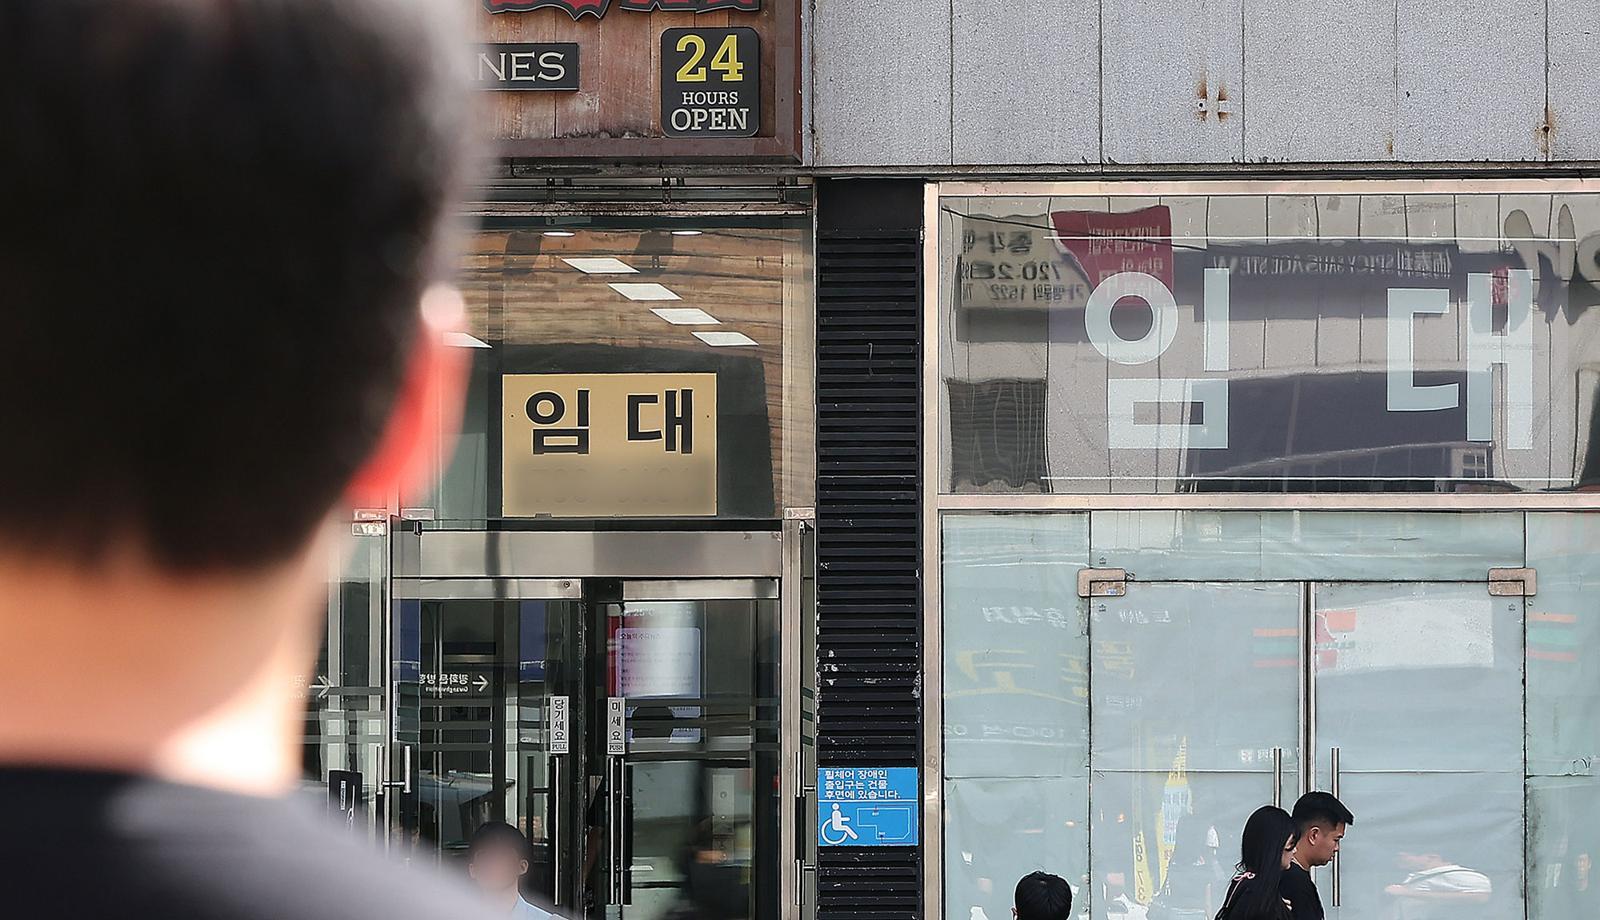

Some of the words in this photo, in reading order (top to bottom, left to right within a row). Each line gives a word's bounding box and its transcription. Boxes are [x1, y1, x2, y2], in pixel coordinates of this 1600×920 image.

[474, 51, 565, 82] NES
[675, 34, 743, 82] 24
[682, 91, 738, 105] HOURS
[670, 108, 749, 131] OPEN
[554, 699, 565, 741] 당기세요
[611, 701, 621, 741] 미세요
[825, 770, 854, 780] 휠체어
[858, 770, 888, 780] 장애인
[825, 780, 865, 790] 출입구는
[868, 780, 888, 790] 건물
[825, 790, 855, 800] 후면에
[858, 790, 901, 800] 있습니다.
